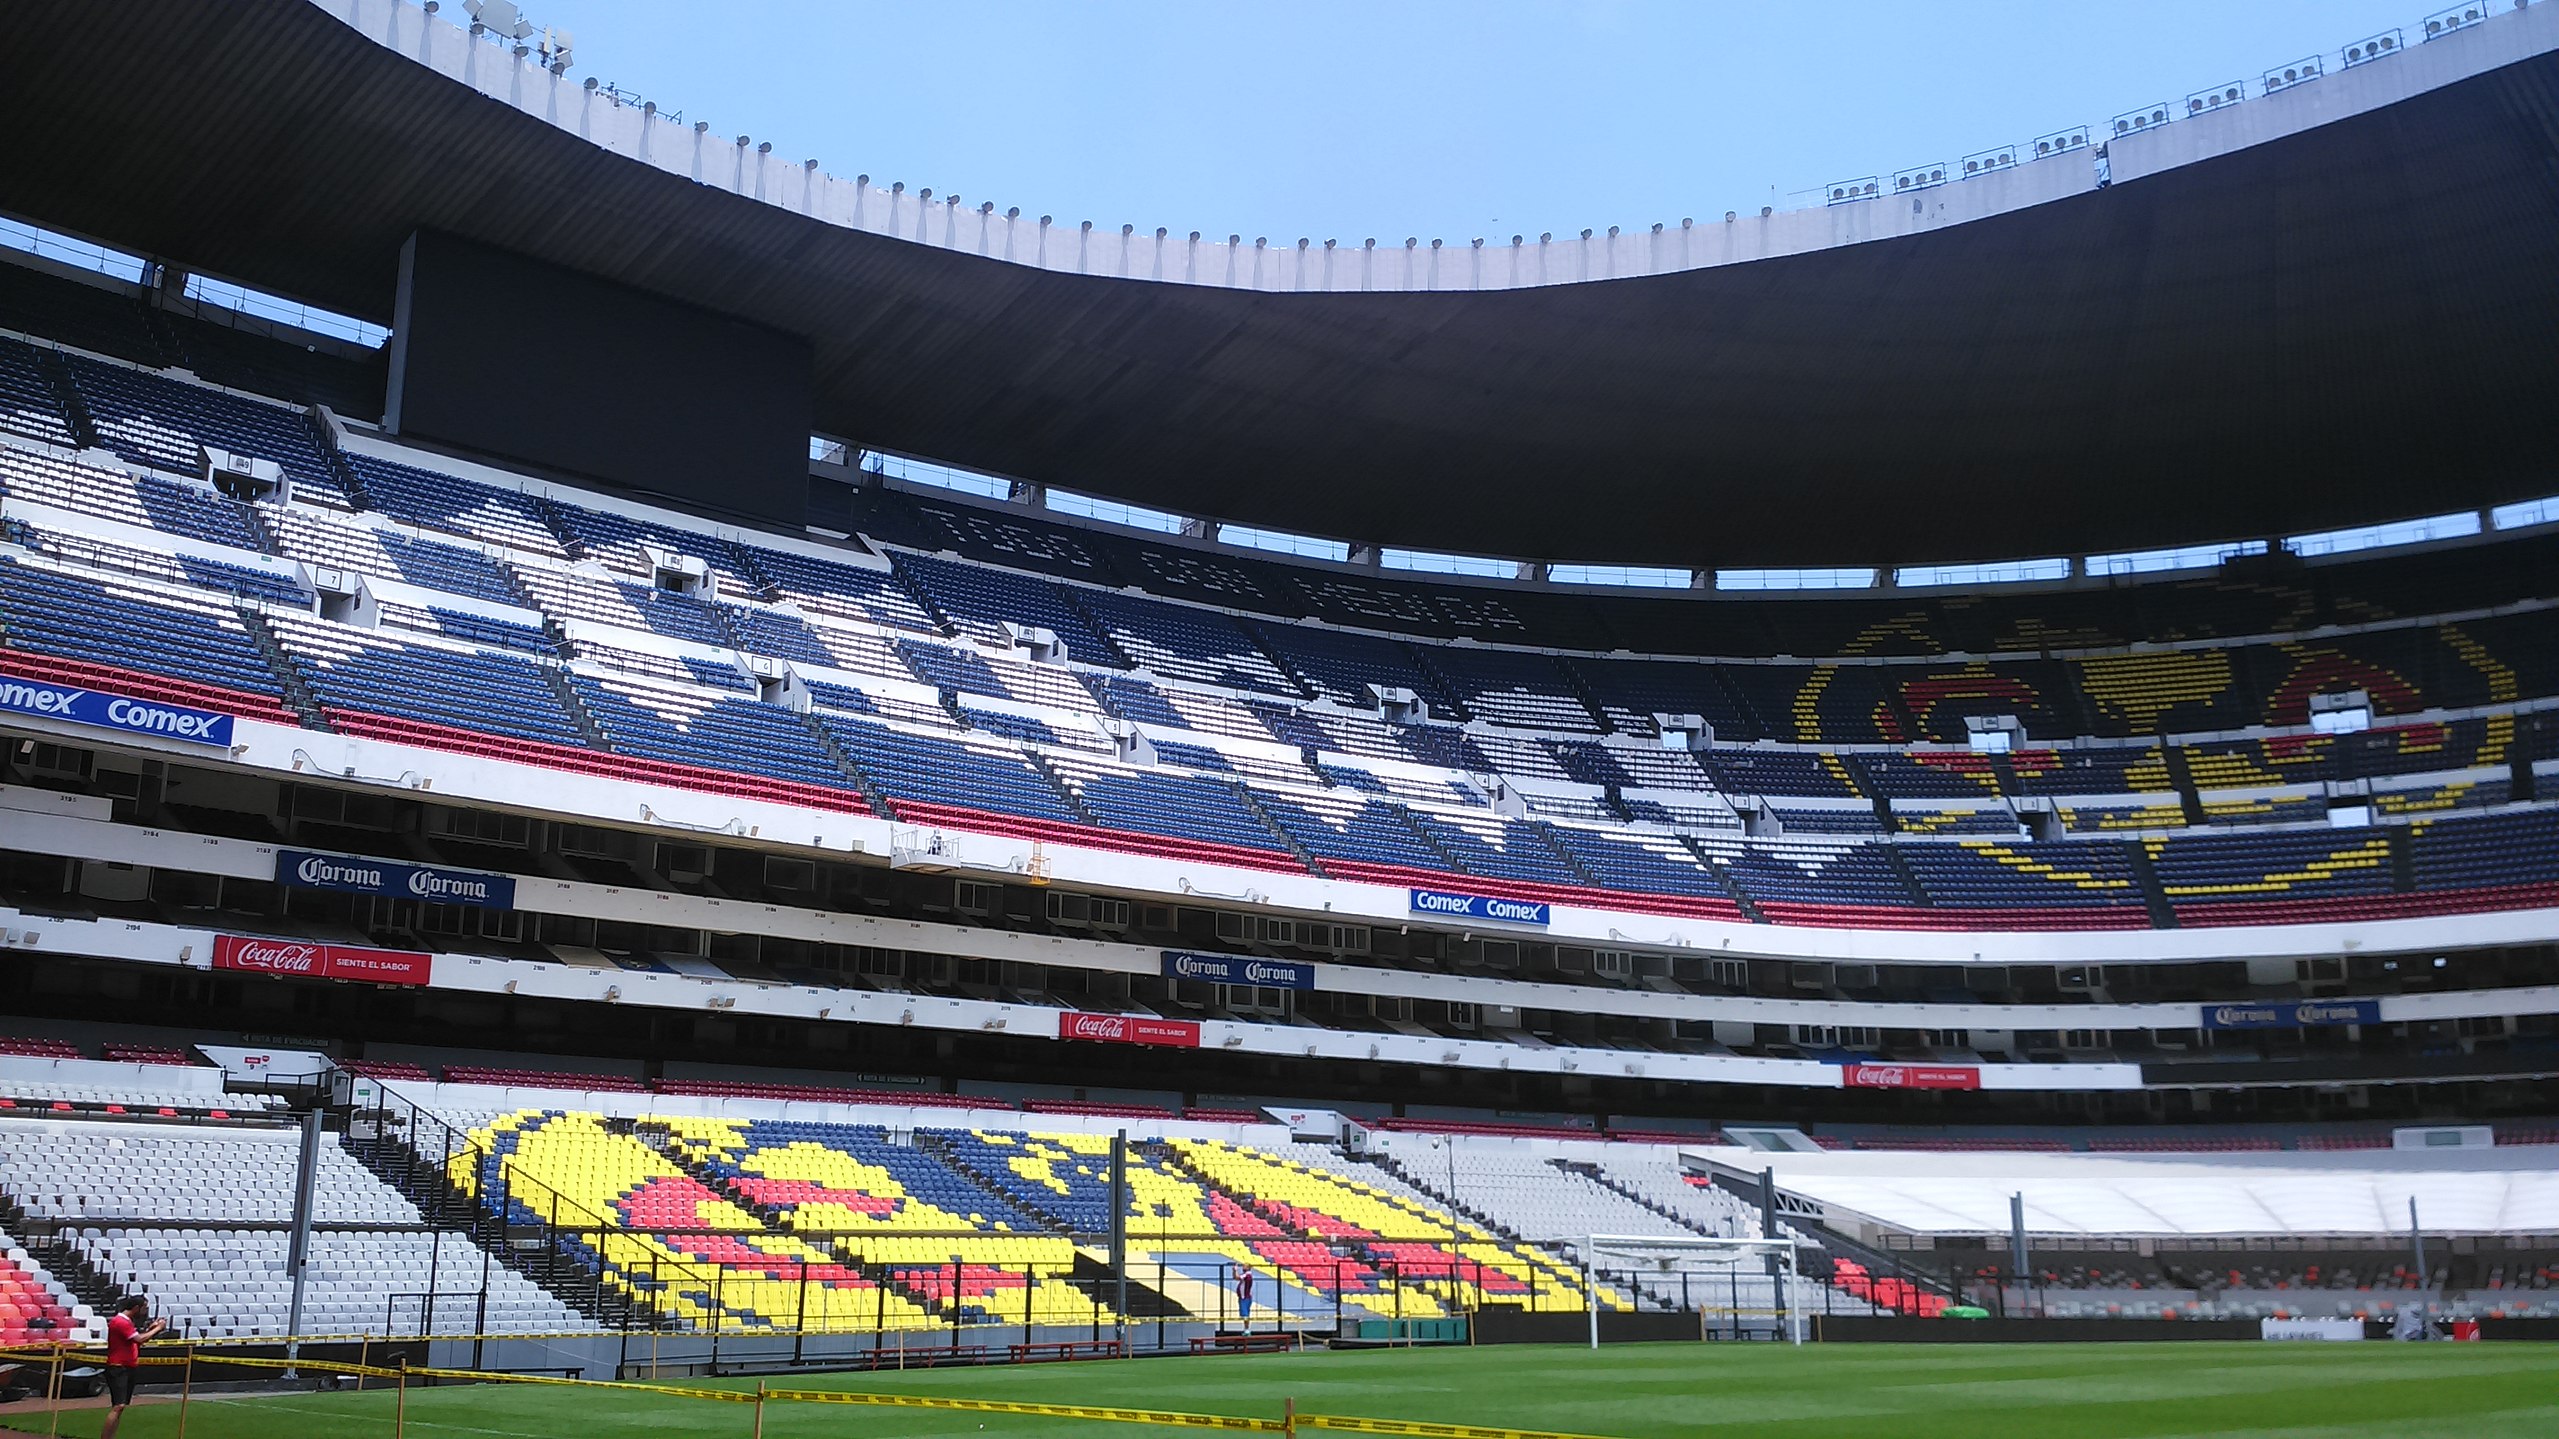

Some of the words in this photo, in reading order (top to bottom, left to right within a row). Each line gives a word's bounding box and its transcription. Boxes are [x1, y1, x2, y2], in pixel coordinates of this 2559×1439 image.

[331, 575, 337, 584] 7
[0, 683, 87, 714] mex
[107, 699, 224, 738] Comex
[298, 857, 384, 886] Corona
[408, 870, 490, 898] Corona
[1417, 892, 1475, 913] Comex
[1486, 900, 1543, 921] Comex
[237, 941, 317, 971] Coca-Cola
[336, 958, 367, 968] SIENTE
[369, 960, 379, 969] EL
[381, 961, 411, 971] SABOR
[1175, 955, 1230, 978] Corona
[1245, 961, 1298, 984] Corona
[1075, 1015, 1125, 1038] Coca-Cola
